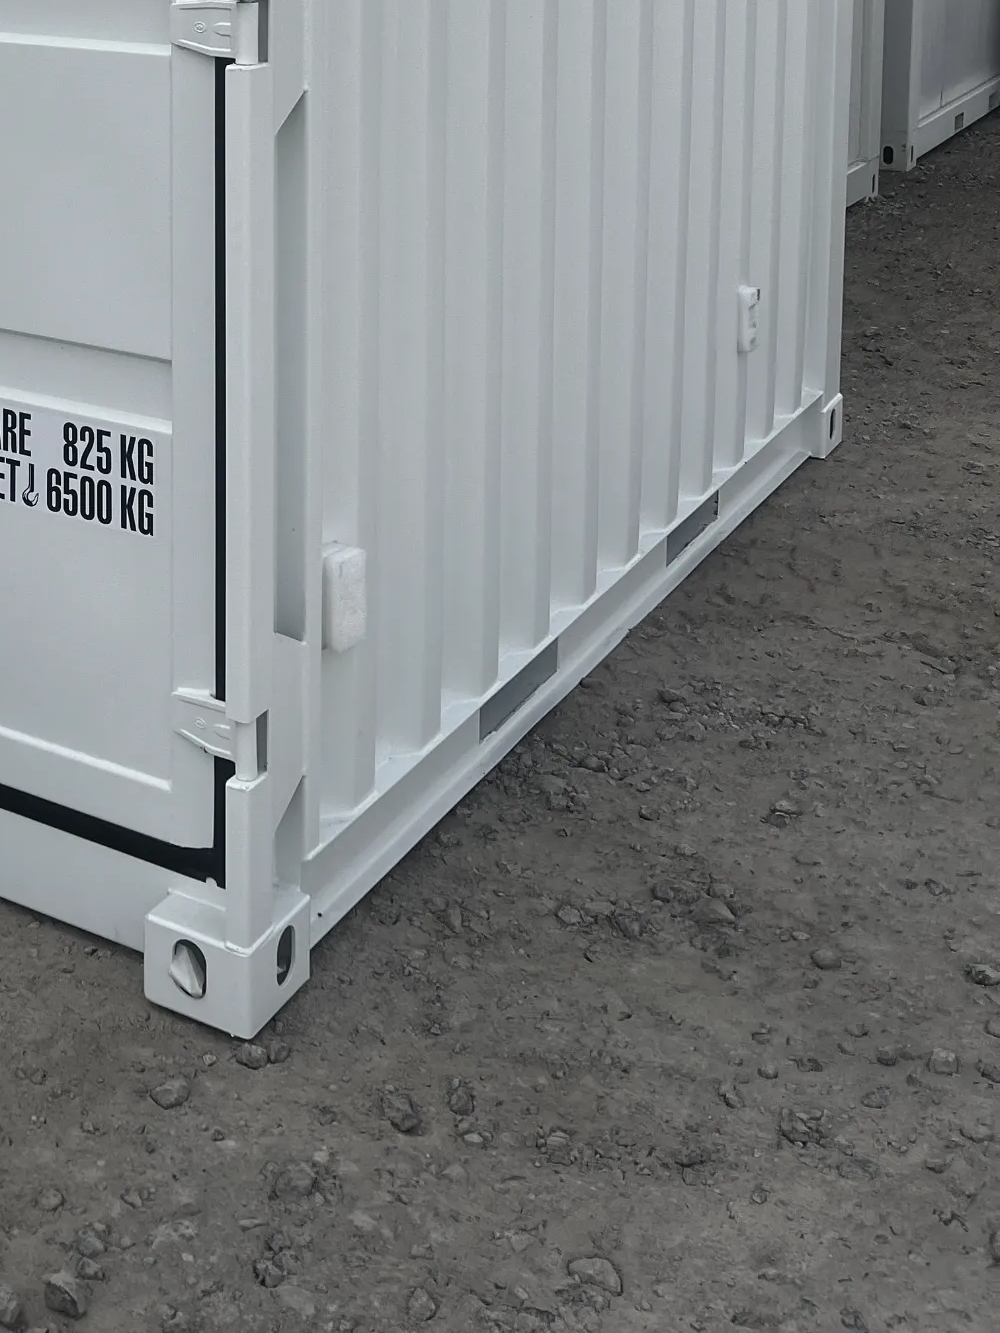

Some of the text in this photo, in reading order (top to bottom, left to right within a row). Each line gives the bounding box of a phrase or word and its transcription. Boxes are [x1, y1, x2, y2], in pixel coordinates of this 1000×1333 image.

[63, 422, 112, 474] 825
[120, 433, 154, 485] KG
[46, 468, 113, 525] 6500
[120, 485, 154, 536] KG
